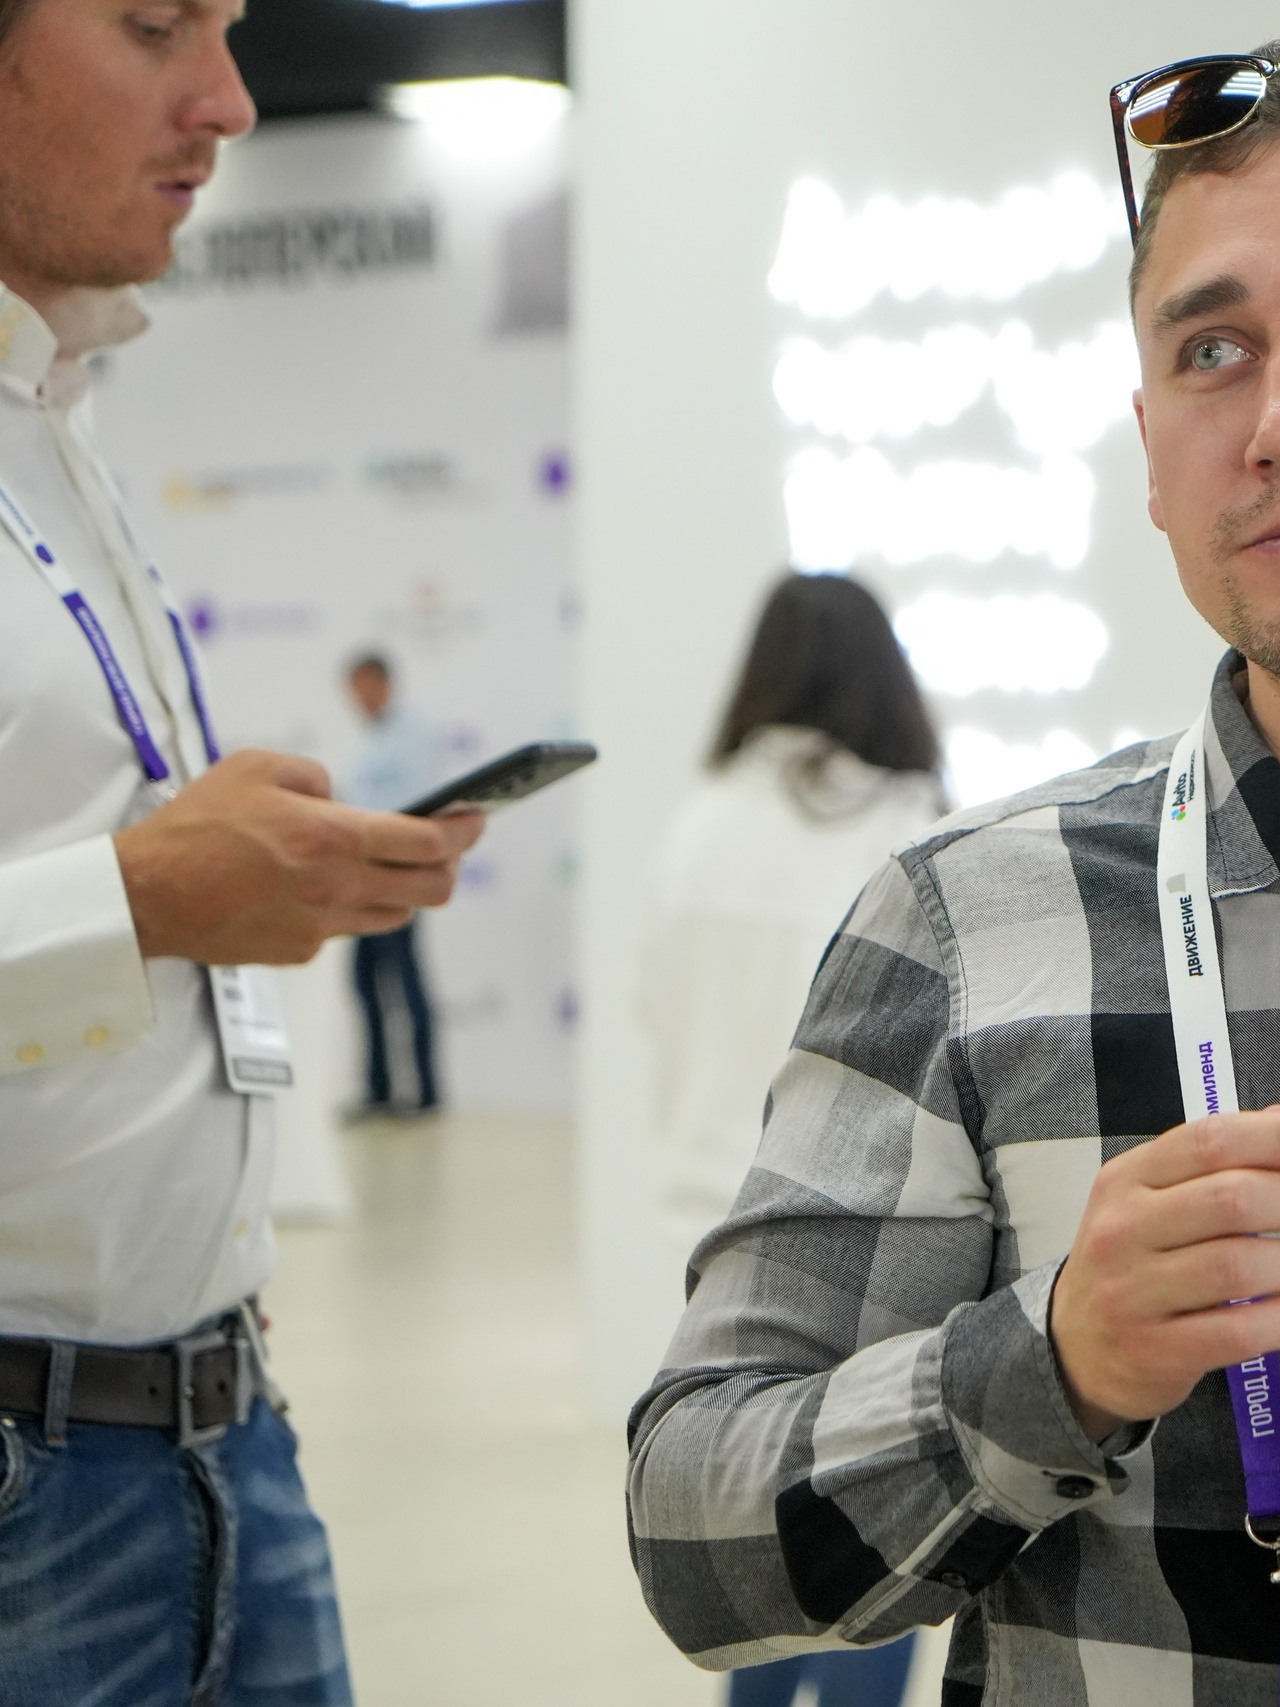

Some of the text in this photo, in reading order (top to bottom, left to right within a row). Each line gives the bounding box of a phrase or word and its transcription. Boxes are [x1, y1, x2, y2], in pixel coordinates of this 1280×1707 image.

[1172, 772, 1187, 807] Avito
[1180, 894, 1204, 977] ДВИЖЕНИЕ
[1243, 1375, 1275, 1437] ГОРОД
